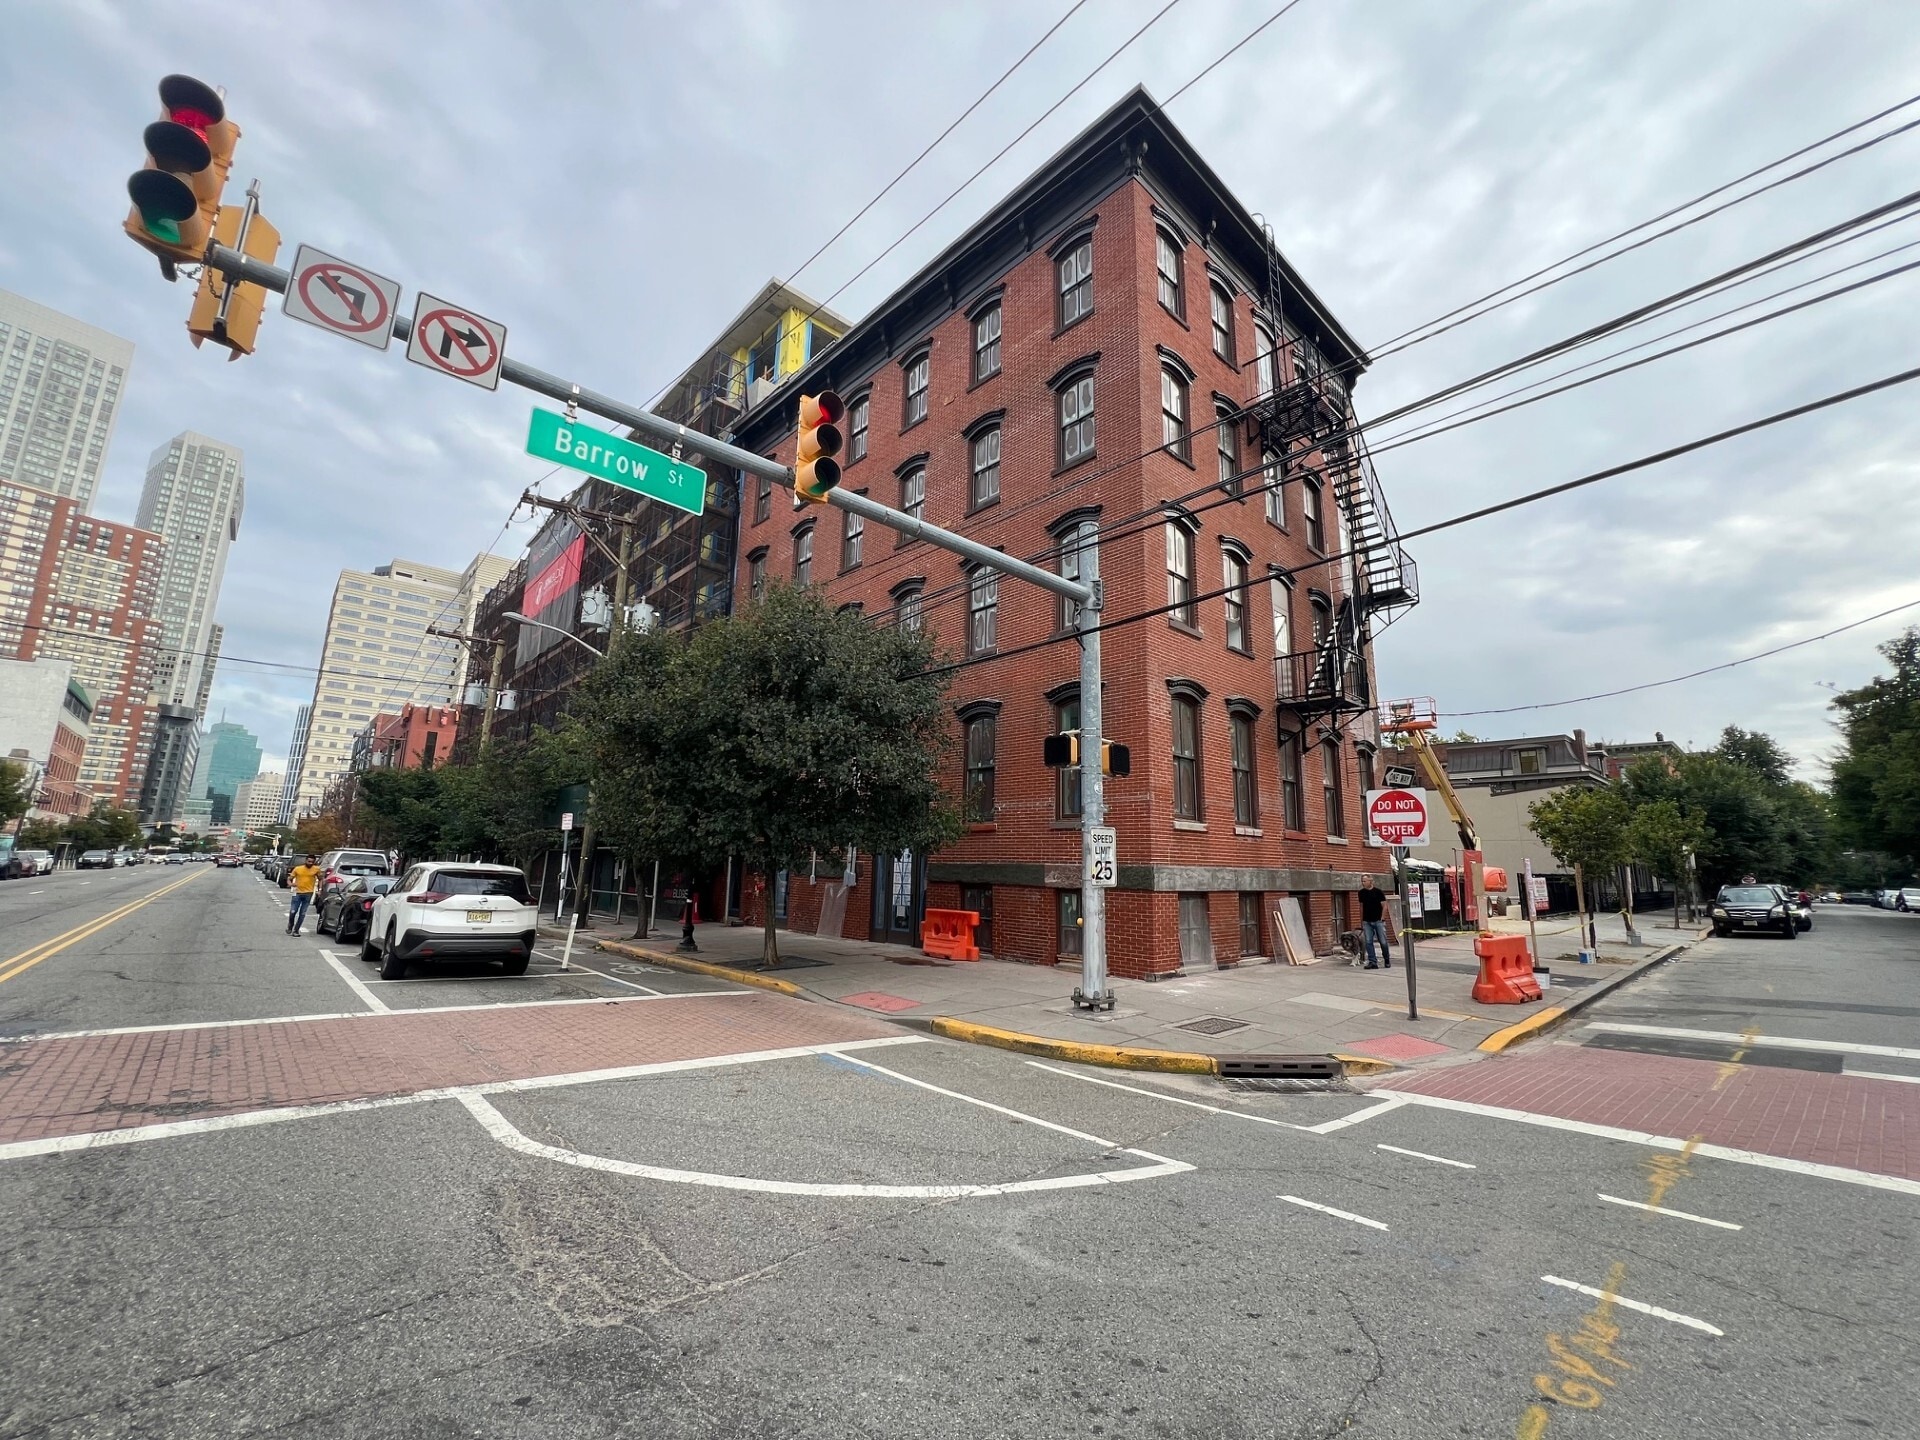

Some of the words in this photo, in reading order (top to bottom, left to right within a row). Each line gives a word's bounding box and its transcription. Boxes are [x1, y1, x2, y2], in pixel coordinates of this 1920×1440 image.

[555, 427, 649, 481] Barrow
[668, 470, 684, 488] St
[1378, 801, 1391, 810] DO
[1396, 800, 1415, 810] NOT
[1382, 825, 1415, 835] ENTER
[1093, 834, 1113, 843] SPEED
[1095, 846, 1111, 855] LIMIT
[1095, 860, 1113, 880] 25
